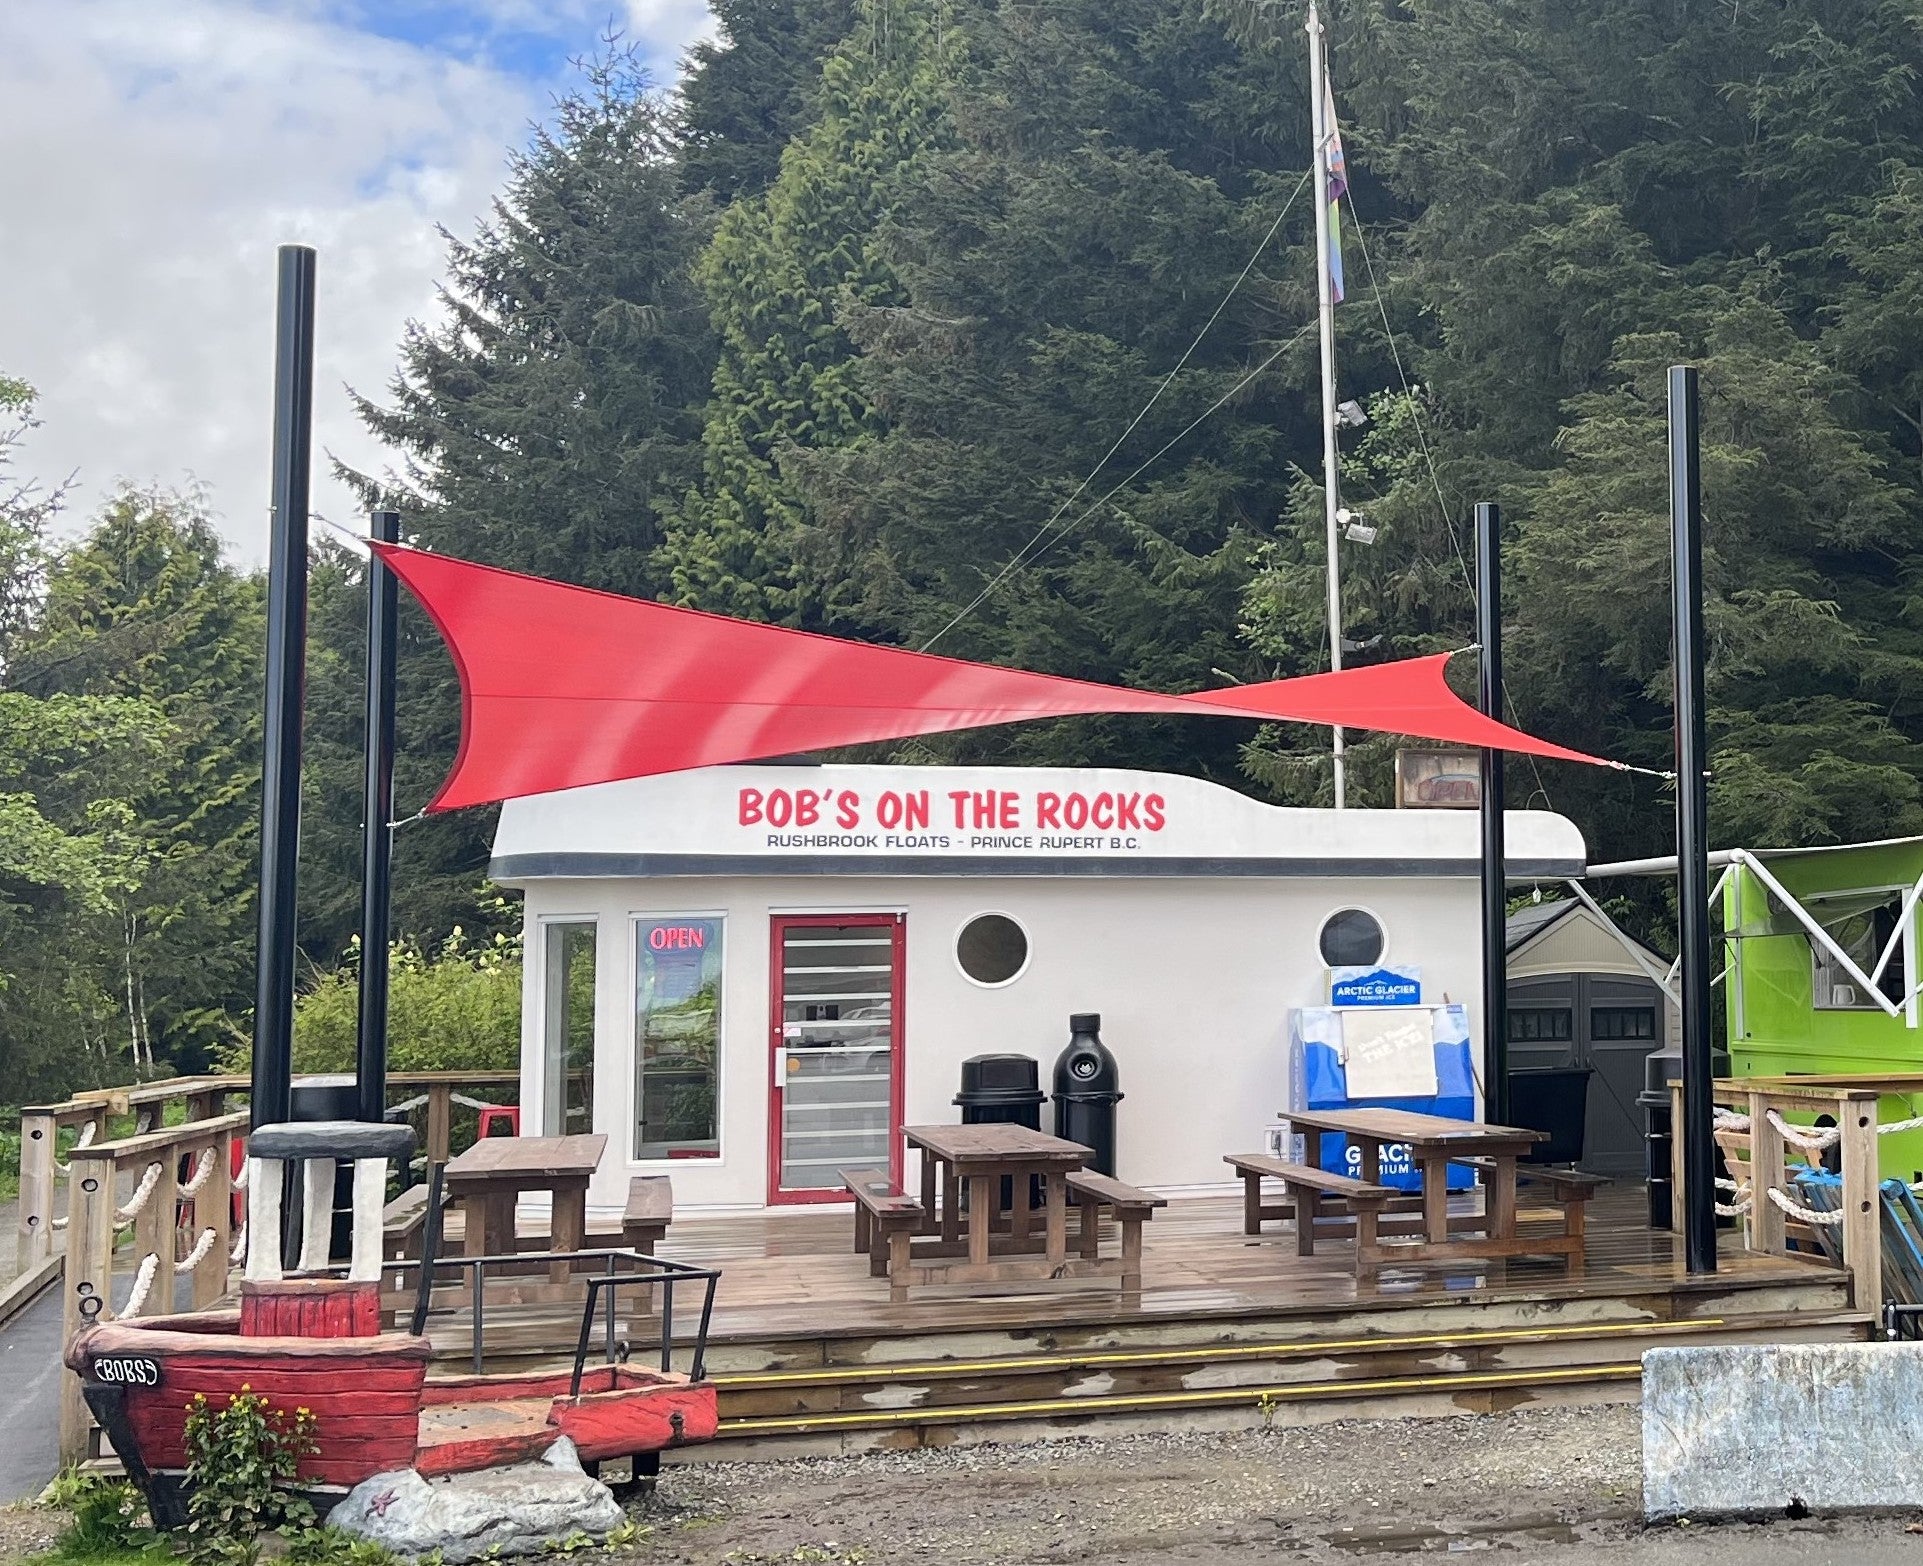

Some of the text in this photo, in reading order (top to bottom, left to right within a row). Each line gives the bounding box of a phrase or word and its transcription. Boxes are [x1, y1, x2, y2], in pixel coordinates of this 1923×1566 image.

[739, 788, 1165, 831] BOB'S ON THE ROCKS
[767, 834, 878, 848] RUSHBROOK
[885, 835, 950, 848] FLOATS
[970, 836, 1032, 849] PRINCE
[1039, 836, 1104, 849] RUPERT
[1110, 837, 1141, 849] B.C.
[650, 927, 704, 950] OPEN
[1337, 985, 1416, 996] ARCTIC GLACIER
[102, 1359, 147, 1383] BOBS
